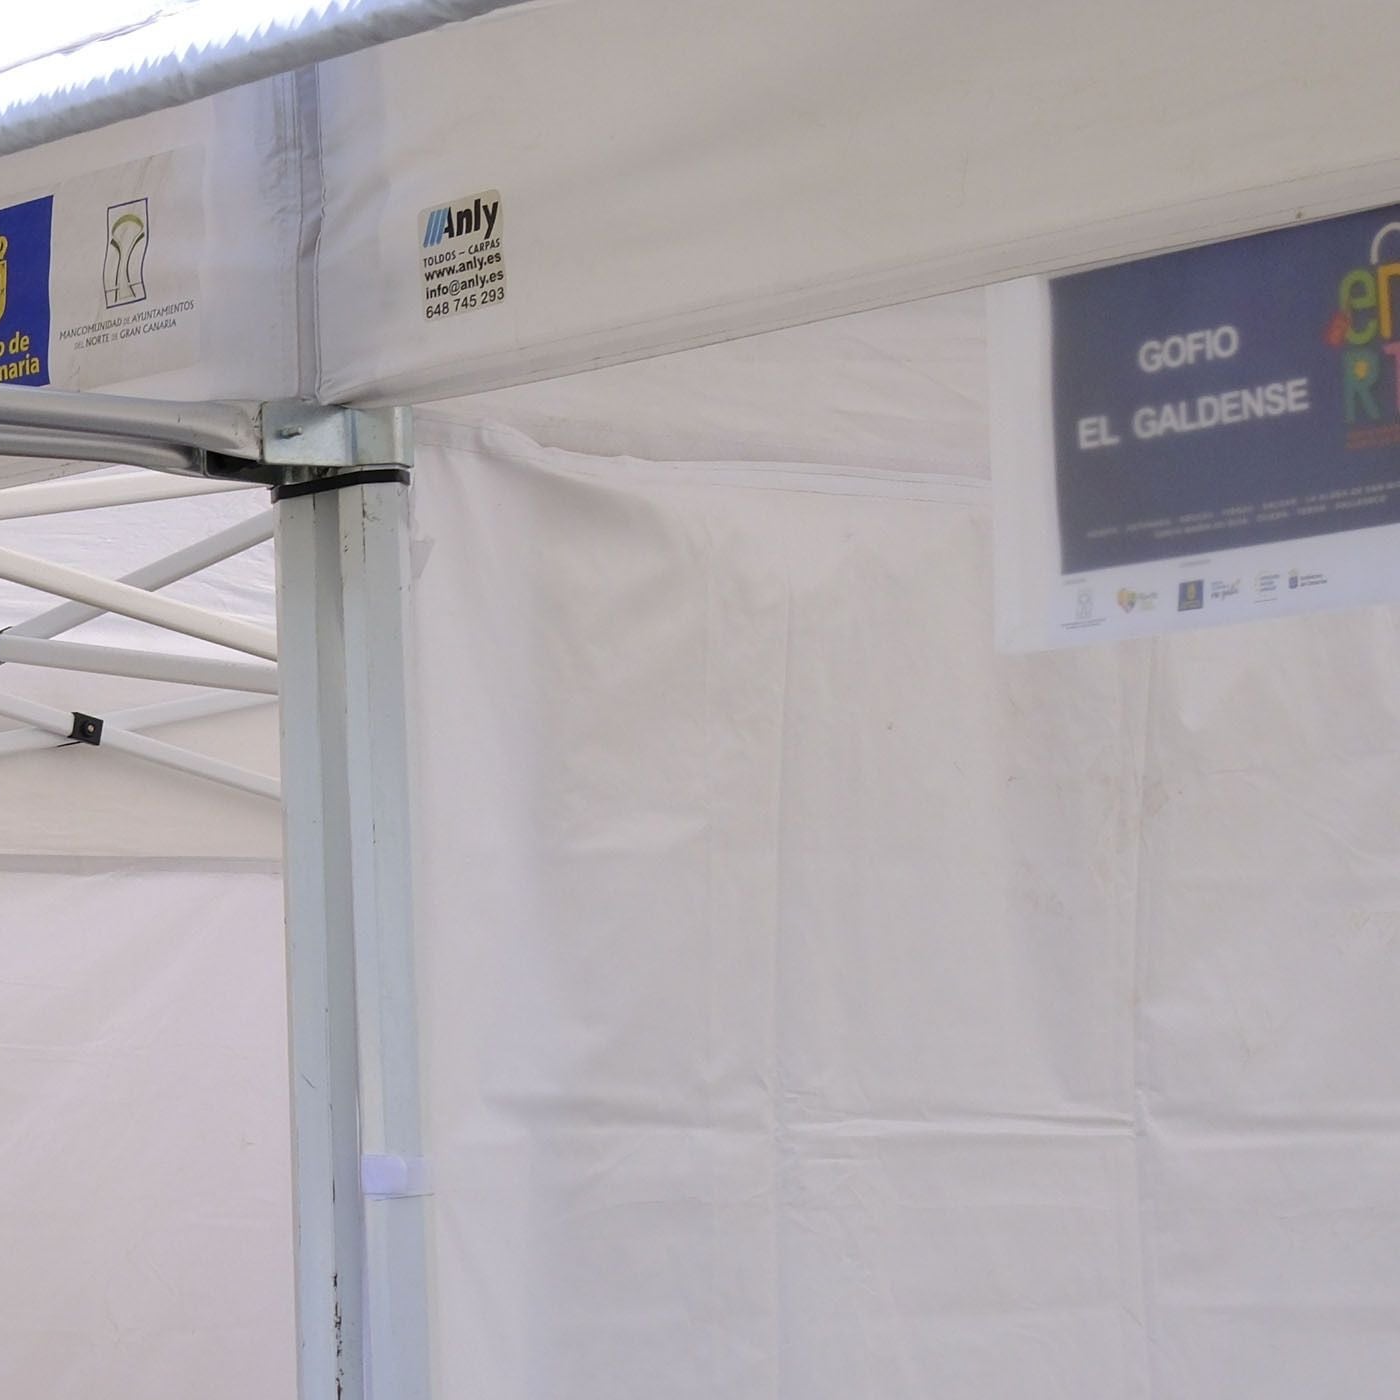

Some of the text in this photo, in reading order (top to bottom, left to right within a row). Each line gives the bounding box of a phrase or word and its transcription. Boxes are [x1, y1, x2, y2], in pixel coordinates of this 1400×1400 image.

[430, 198, 499, 243] Anly
[423, 250, 456, 268] TOLDOS
[468, 238, 500, 255] CARPAS
[424, 252, 502, 281] www.anly.es
[426, 270, 504, 300] info@anly.es
[426, 287, 505, 319] 648 745 293
[58, 317, 122, 341] MANCOMUNIDAD
[131, 300, 195, 323] AYUNTAMIENTOS
[85, 333, 110, 348] NORTE
[119, 326, 142, 339] GRAN
[142, 318, 177, 334] CANARIA
[8, 331, 30, 355] de
[1137, 324, 1240, 374] GOFIO
[1077, 414, 1121, 450] EL
[1132, 377, 1311, 440] GALDENSE
